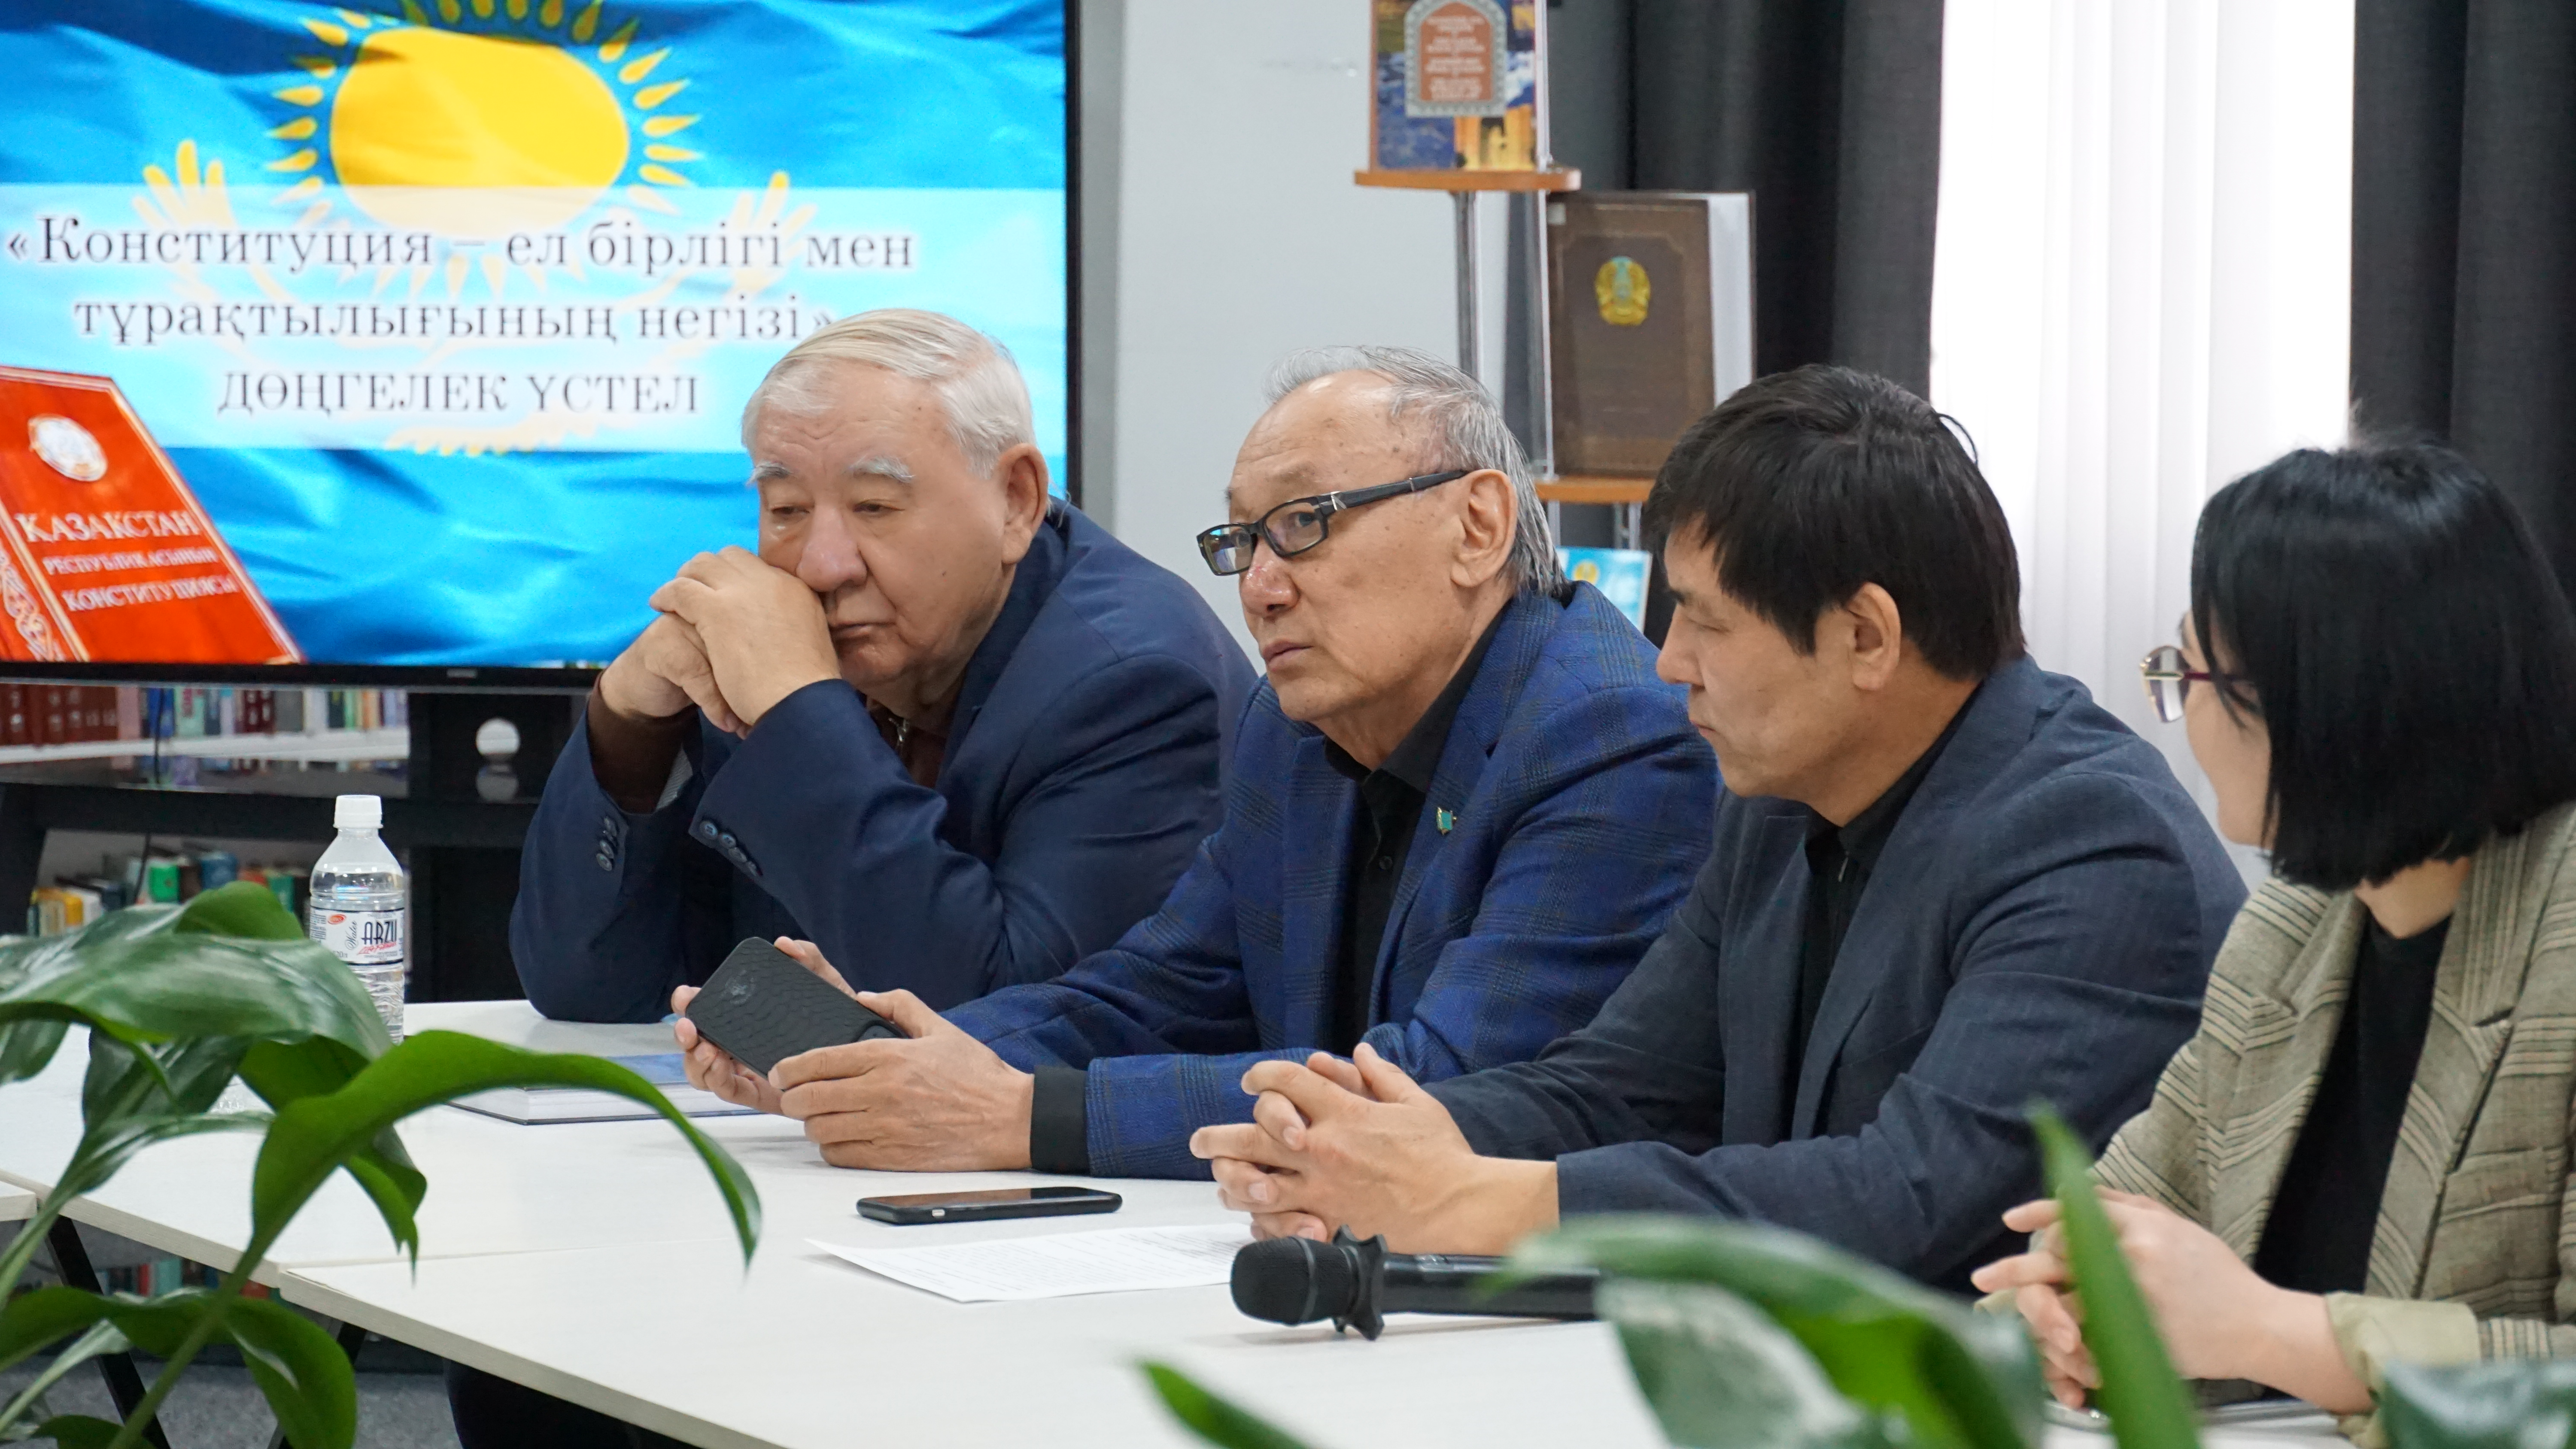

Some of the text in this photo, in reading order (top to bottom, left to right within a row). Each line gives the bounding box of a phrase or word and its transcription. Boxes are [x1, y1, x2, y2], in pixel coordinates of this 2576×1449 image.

[9, 216, 432, 274] «Конституция
[506, 233, 567, 266] ел
[588, 221, 784, 276] бірлігі
[805, 234, 912, 267] мен
[74, 301, 617, 345] тұрақтылығының
[218, 372, 698, 416] ДӨҢГЕЛЕК ҮСТЕЛ
